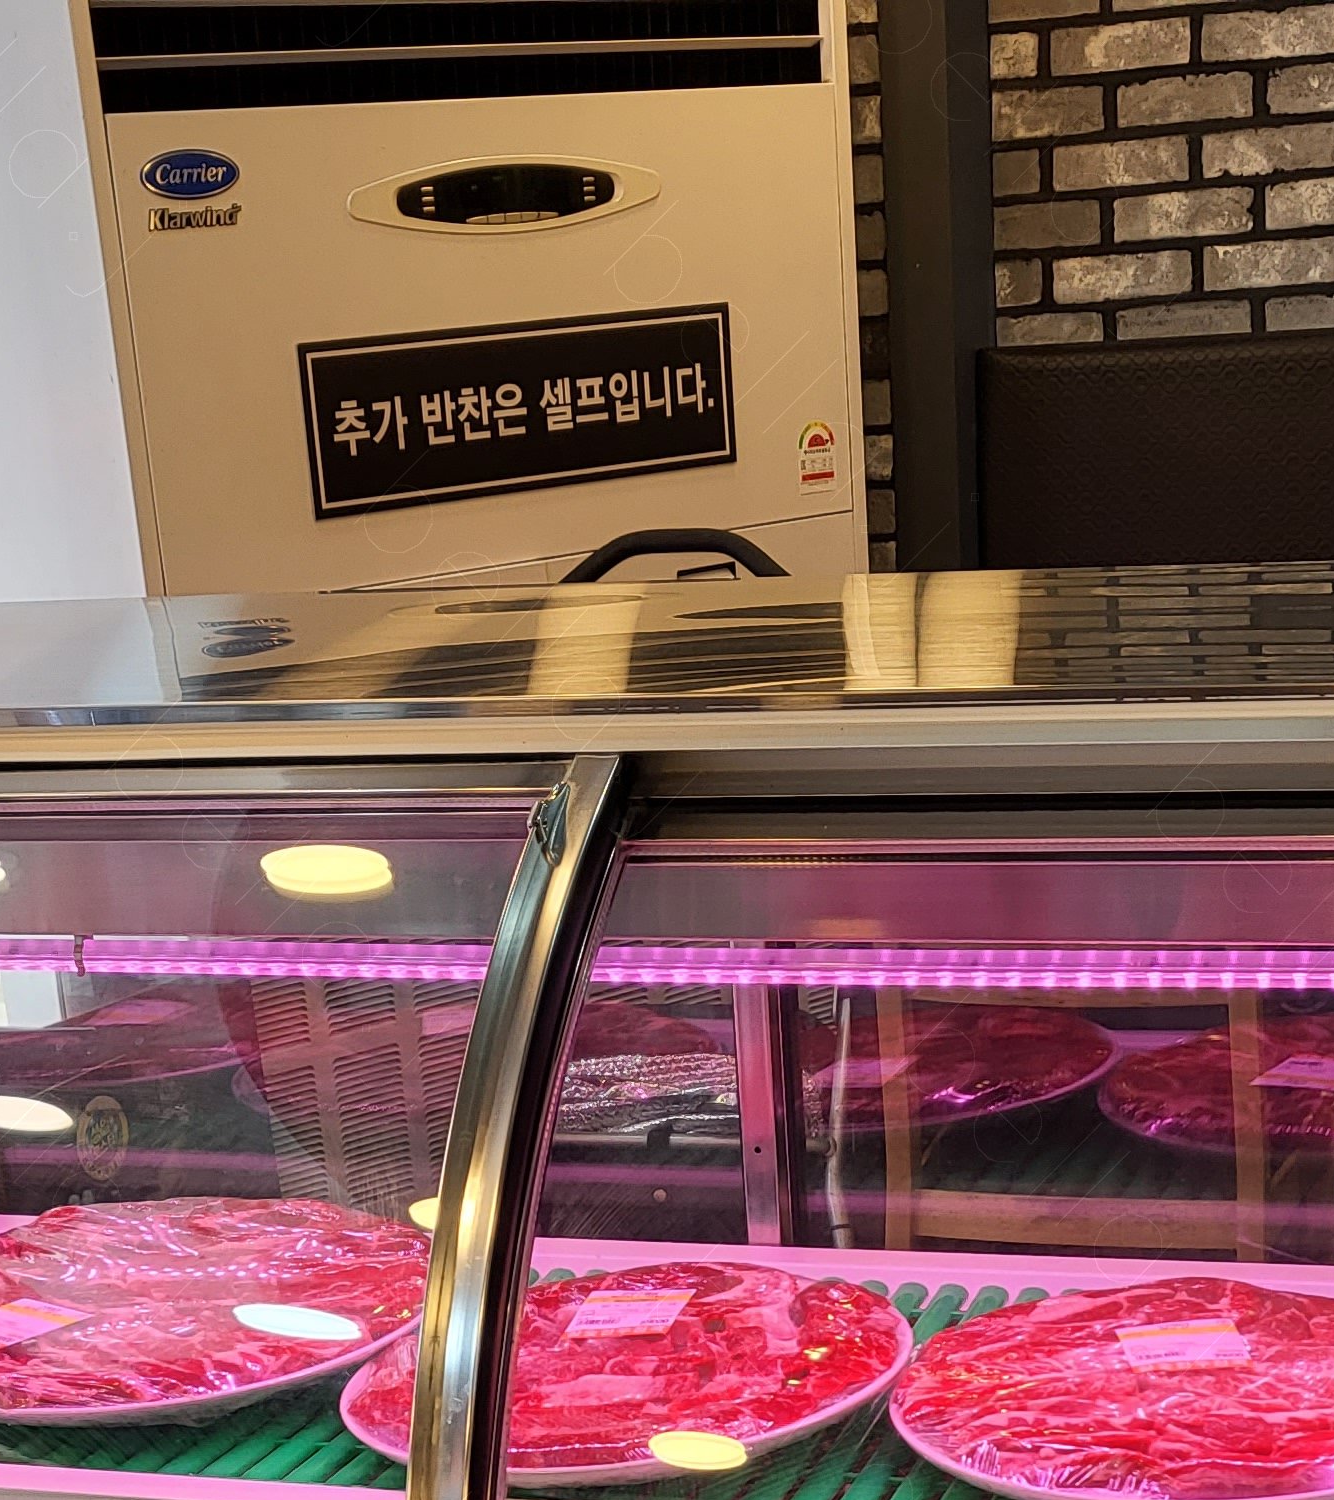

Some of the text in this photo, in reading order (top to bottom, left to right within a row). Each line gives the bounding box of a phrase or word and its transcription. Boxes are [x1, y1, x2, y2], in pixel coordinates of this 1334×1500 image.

[155, 162, 227, 185] Carrier
[333, 363, 715, 457] 추가 반찬은 셀프입니다.
